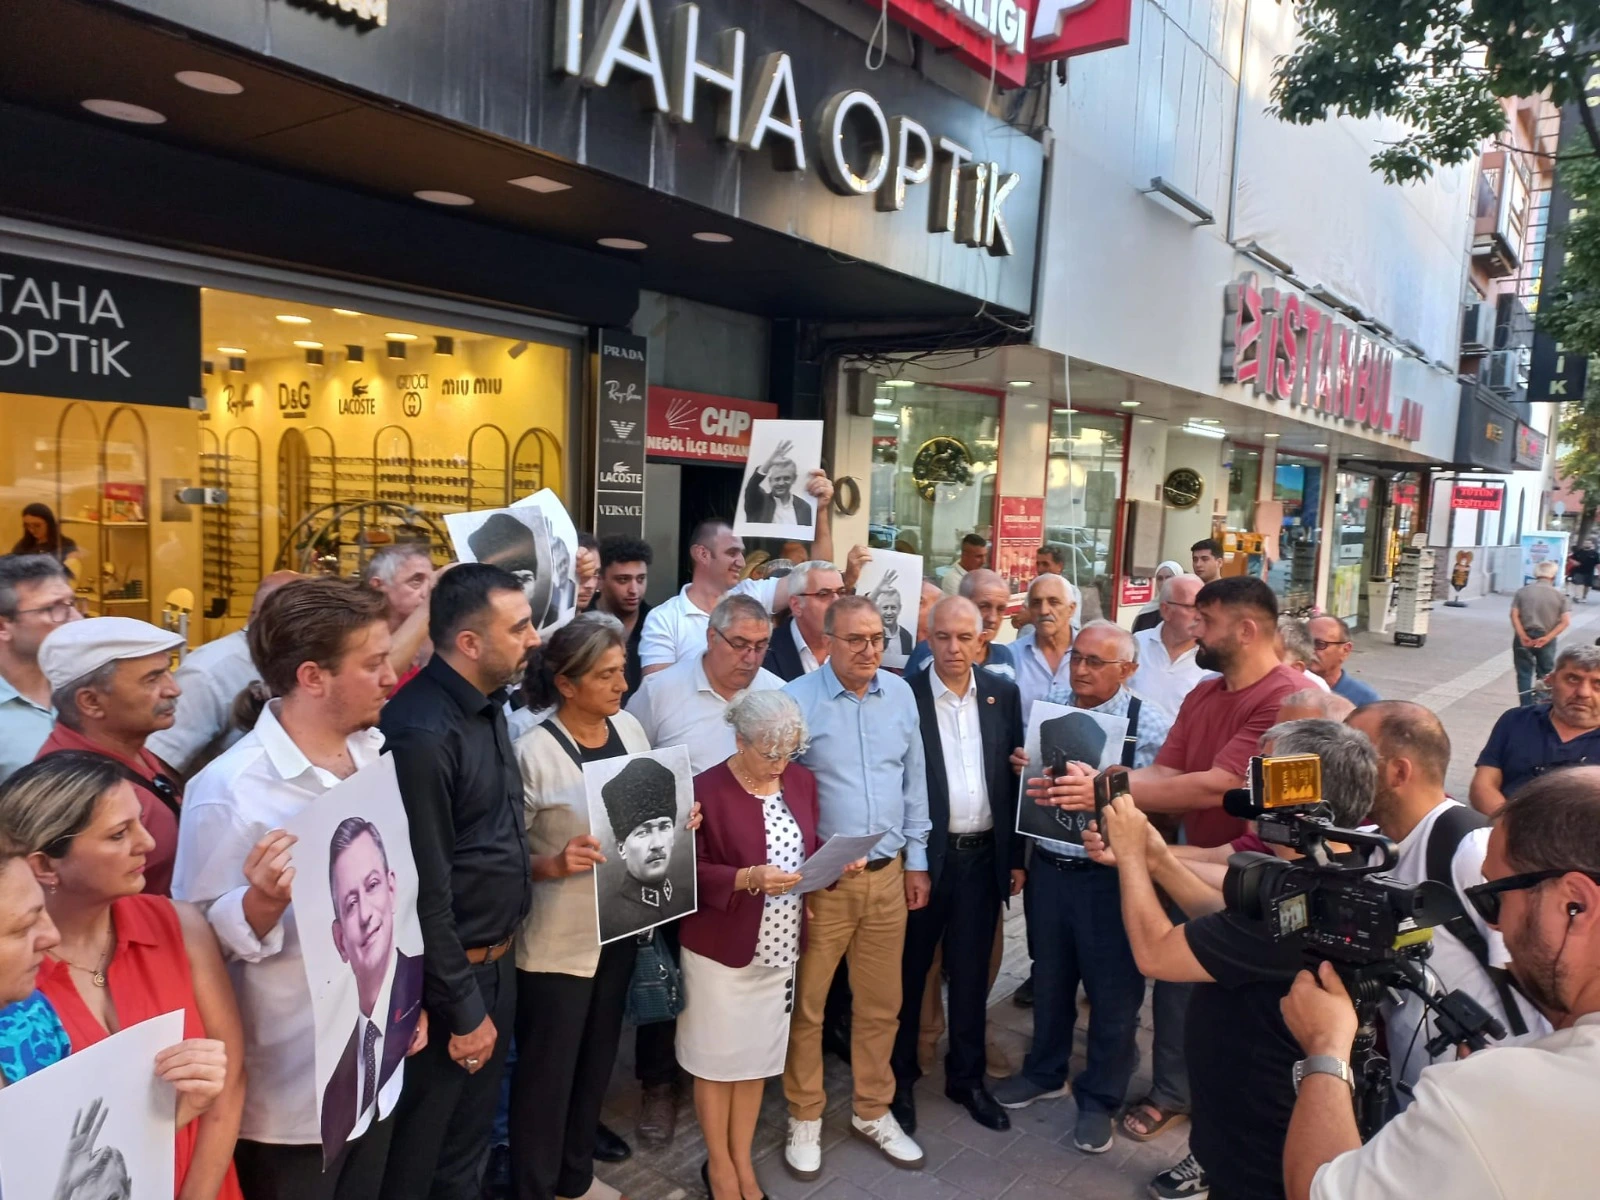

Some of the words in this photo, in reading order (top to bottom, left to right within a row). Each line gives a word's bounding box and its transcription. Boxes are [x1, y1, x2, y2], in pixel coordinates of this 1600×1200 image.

[603, 345, 645, 361] PRADA
[396, 374, 430, 390] GUCCI
[278, 381, 311, 410] D&G
[338, 398, 376, 415] LACOSTE
[700, 406, 751, 438] CHP
[686, 437, 708, 456] İLÇE
[600, 471, 643, 484] LACOSTE
[598, 504, 643, 516] VERSACE
